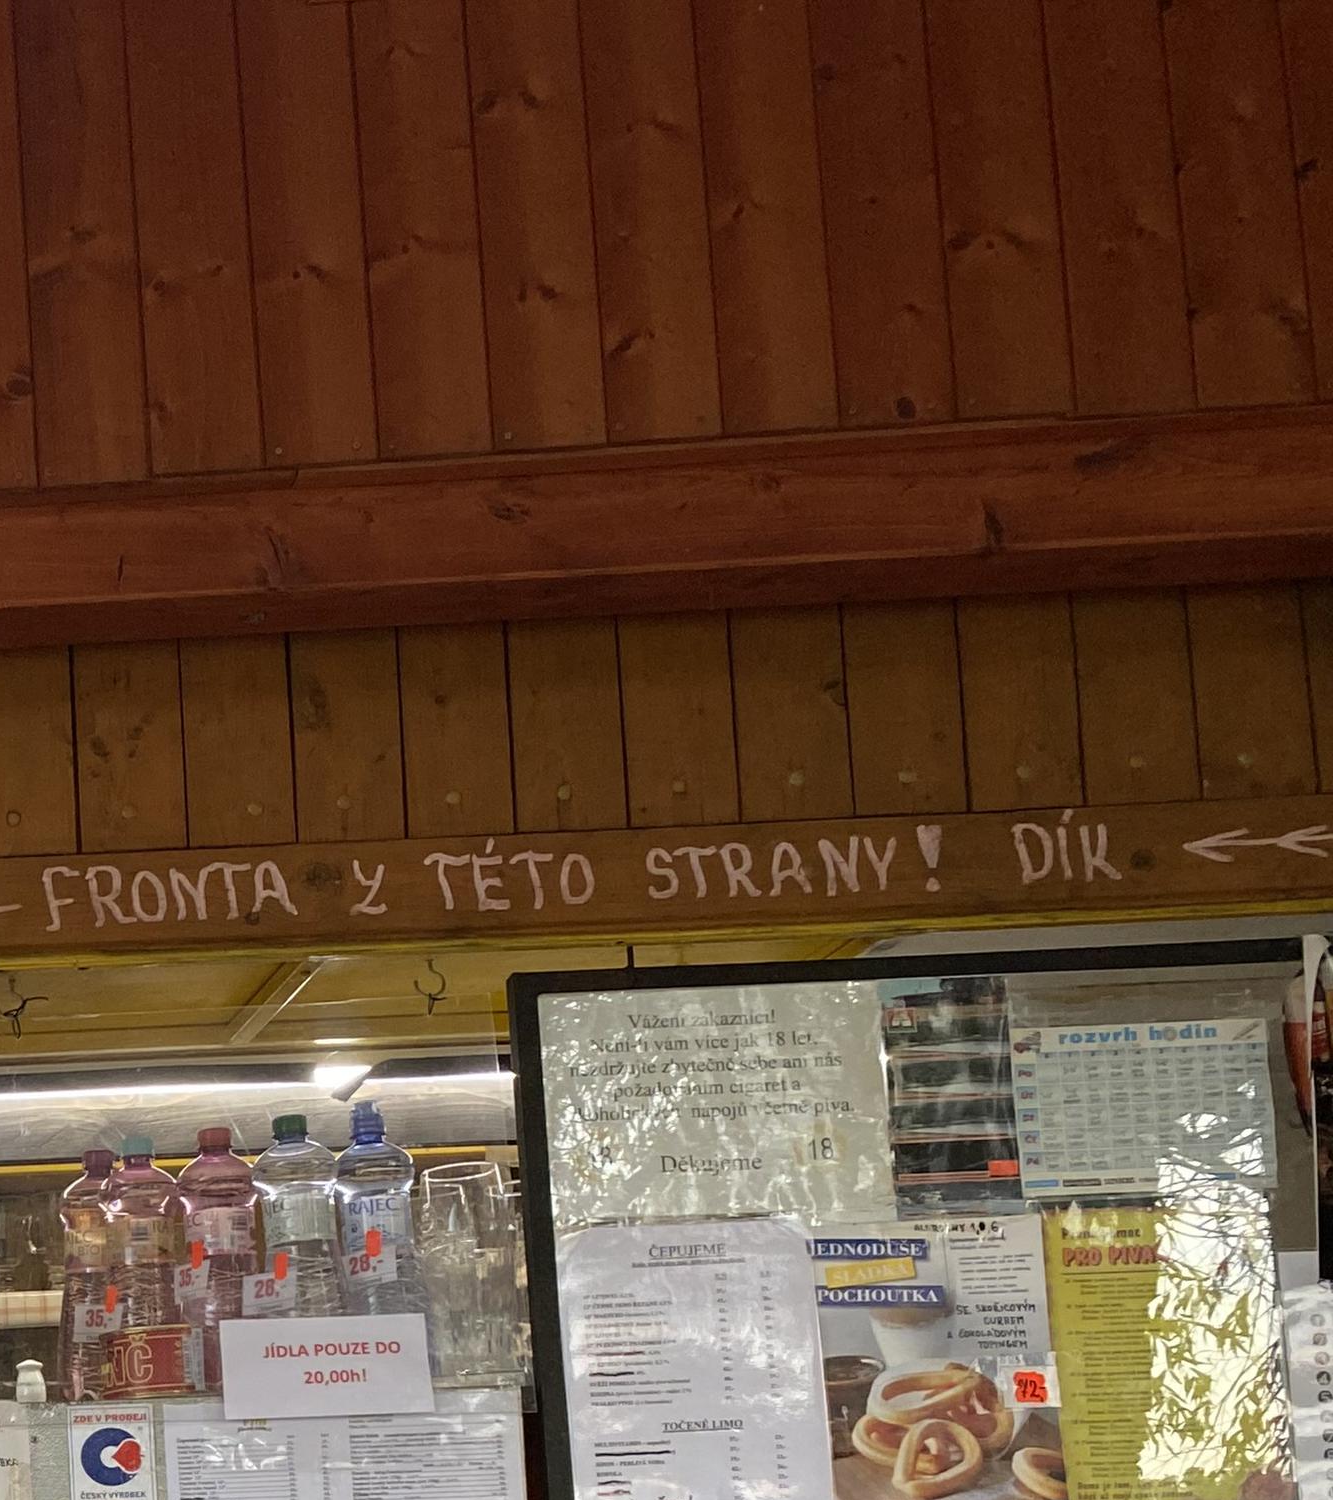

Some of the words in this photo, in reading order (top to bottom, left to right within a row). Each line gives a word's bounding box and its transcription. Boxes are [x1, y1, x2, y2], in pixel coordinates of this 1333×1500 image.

[41, 858, 299, 932] FRONTA
[423, 836, 596, 912] TÉTO
[1010, 808, 1123, 885] DÍK
[1058, 1027, 1138, 1046] rozvrh
[808, 1137, 834, 1161] 18
[347, 1196, 399, 1217] RAJEC
[1063, 1247, 1102, 1267] PRO
[816, 1284, 939, 1304] POCHOUTKA
[262, 1341, 309, 1359] JÍDLA
[313, 1341, 370, 1357] POUZE
[374, 1340, 402, 1355] DO
[303, 1367, 368, 1387] 20,00h!
[73, 1415, 95, 1424] ZDE
[94, 1415, 102, 1423] V
[104, 1413, 147, 1423] PRODEJI
[80, 1490, 108, 1500] ČESKÝ
